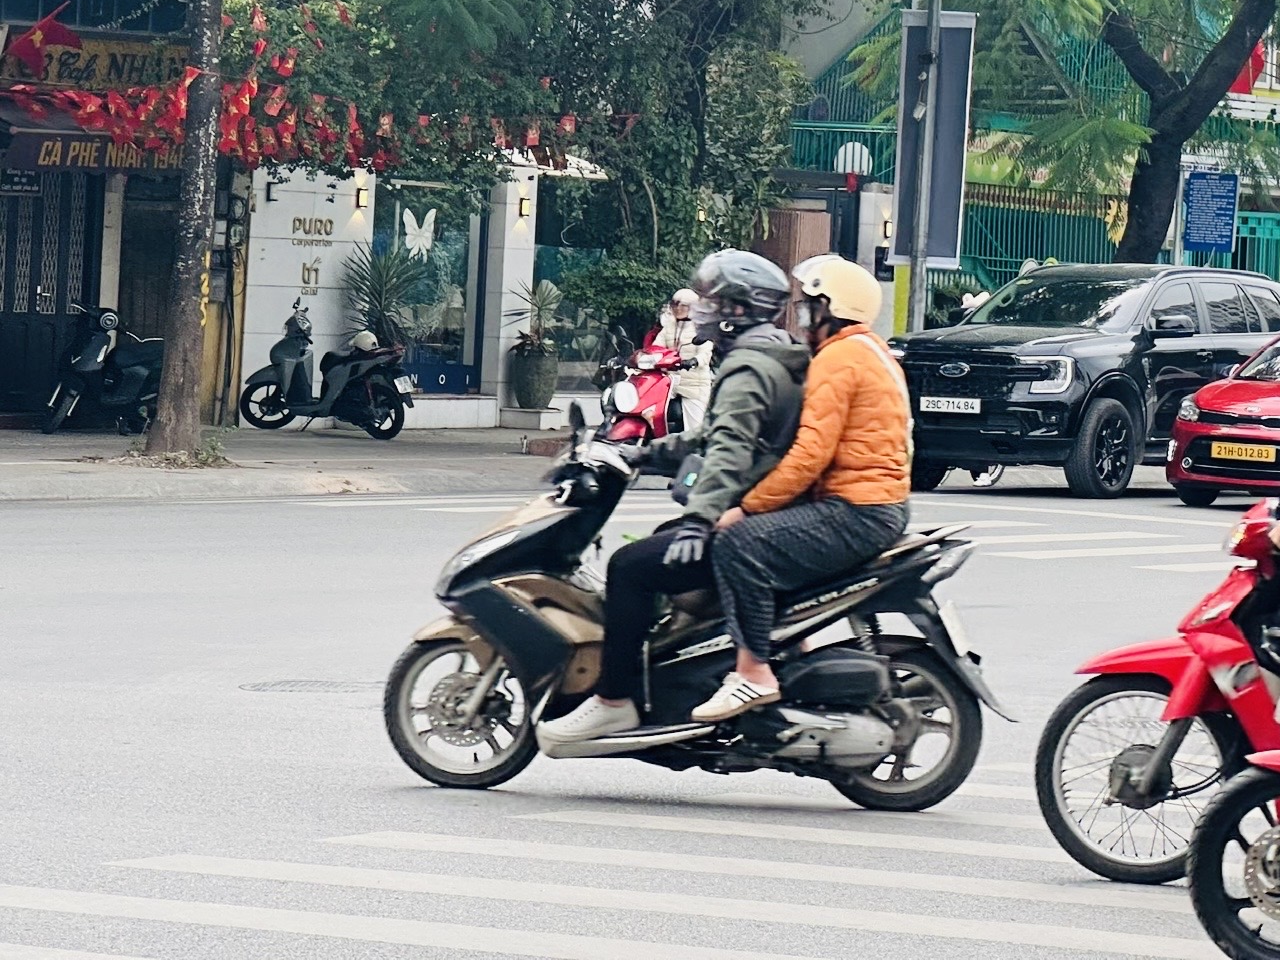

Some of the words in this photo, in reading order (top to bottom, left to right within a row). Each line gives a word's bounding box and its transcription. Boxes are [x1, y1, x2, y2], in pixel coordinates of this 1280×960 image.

[66, 138, 100, 168] PHÊ
[292, 216, 334, 236] PURO
[291, 238, 333, 248] Corporation
[925, 399, 975, 411] 29C-714.84
[1216, 445, 1270, 460] 21H-012.83
